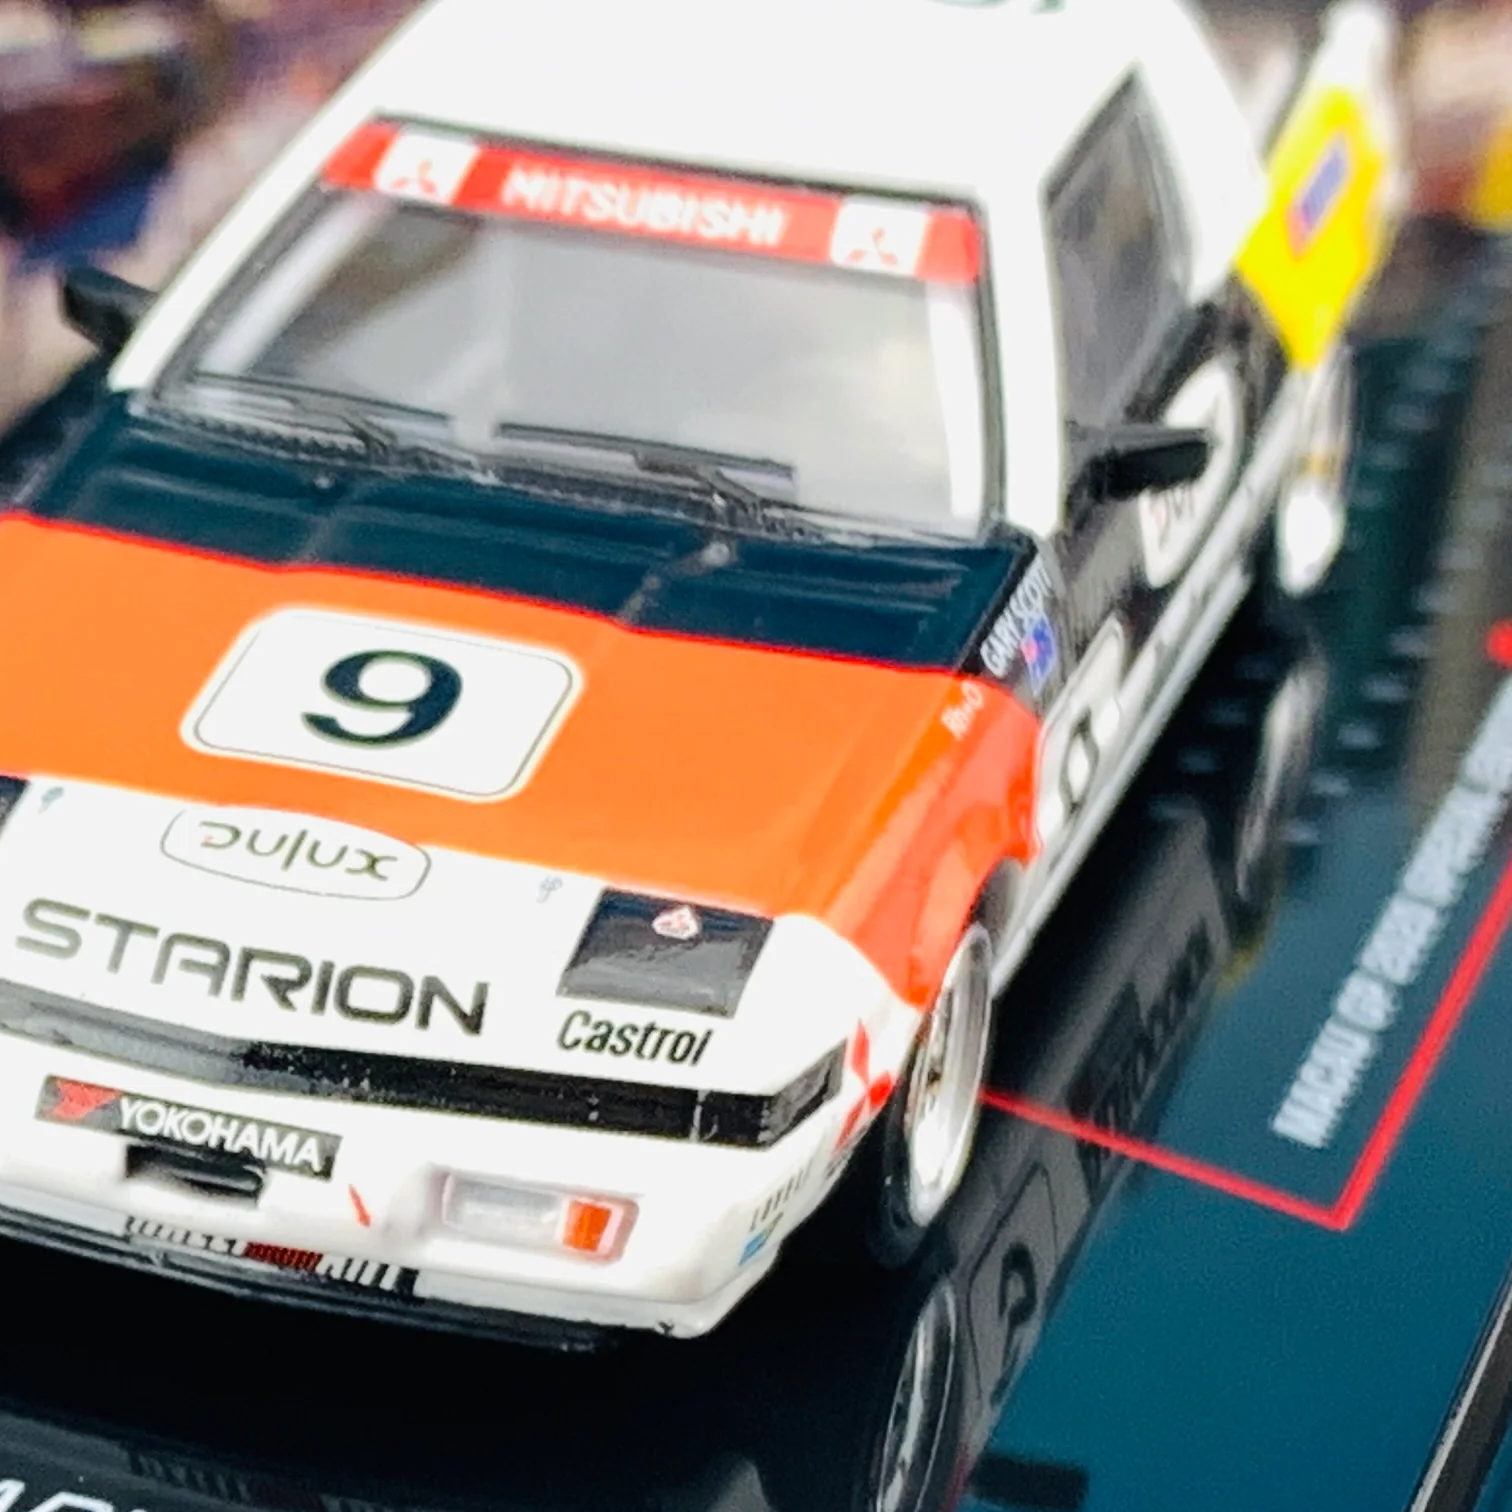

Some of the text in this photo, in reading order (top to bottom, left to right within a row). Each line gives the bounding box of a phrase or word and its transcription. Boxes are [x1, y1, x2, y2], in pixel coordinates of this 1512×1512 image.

[500, 163, 788, 247] MITSUBISHI
[979, 607, 1022, 679] GARY
[300, 650, 463, 750] 9
[15, 898, 491, 1038] STARION
[557, 1008, 714, 1068] Castrol
[1271, 1016, 1376, 1149] MACAU
[1335, 969, 1395, 1032] GP
[116, 1096, 326, 1175] YOKOHAMA
